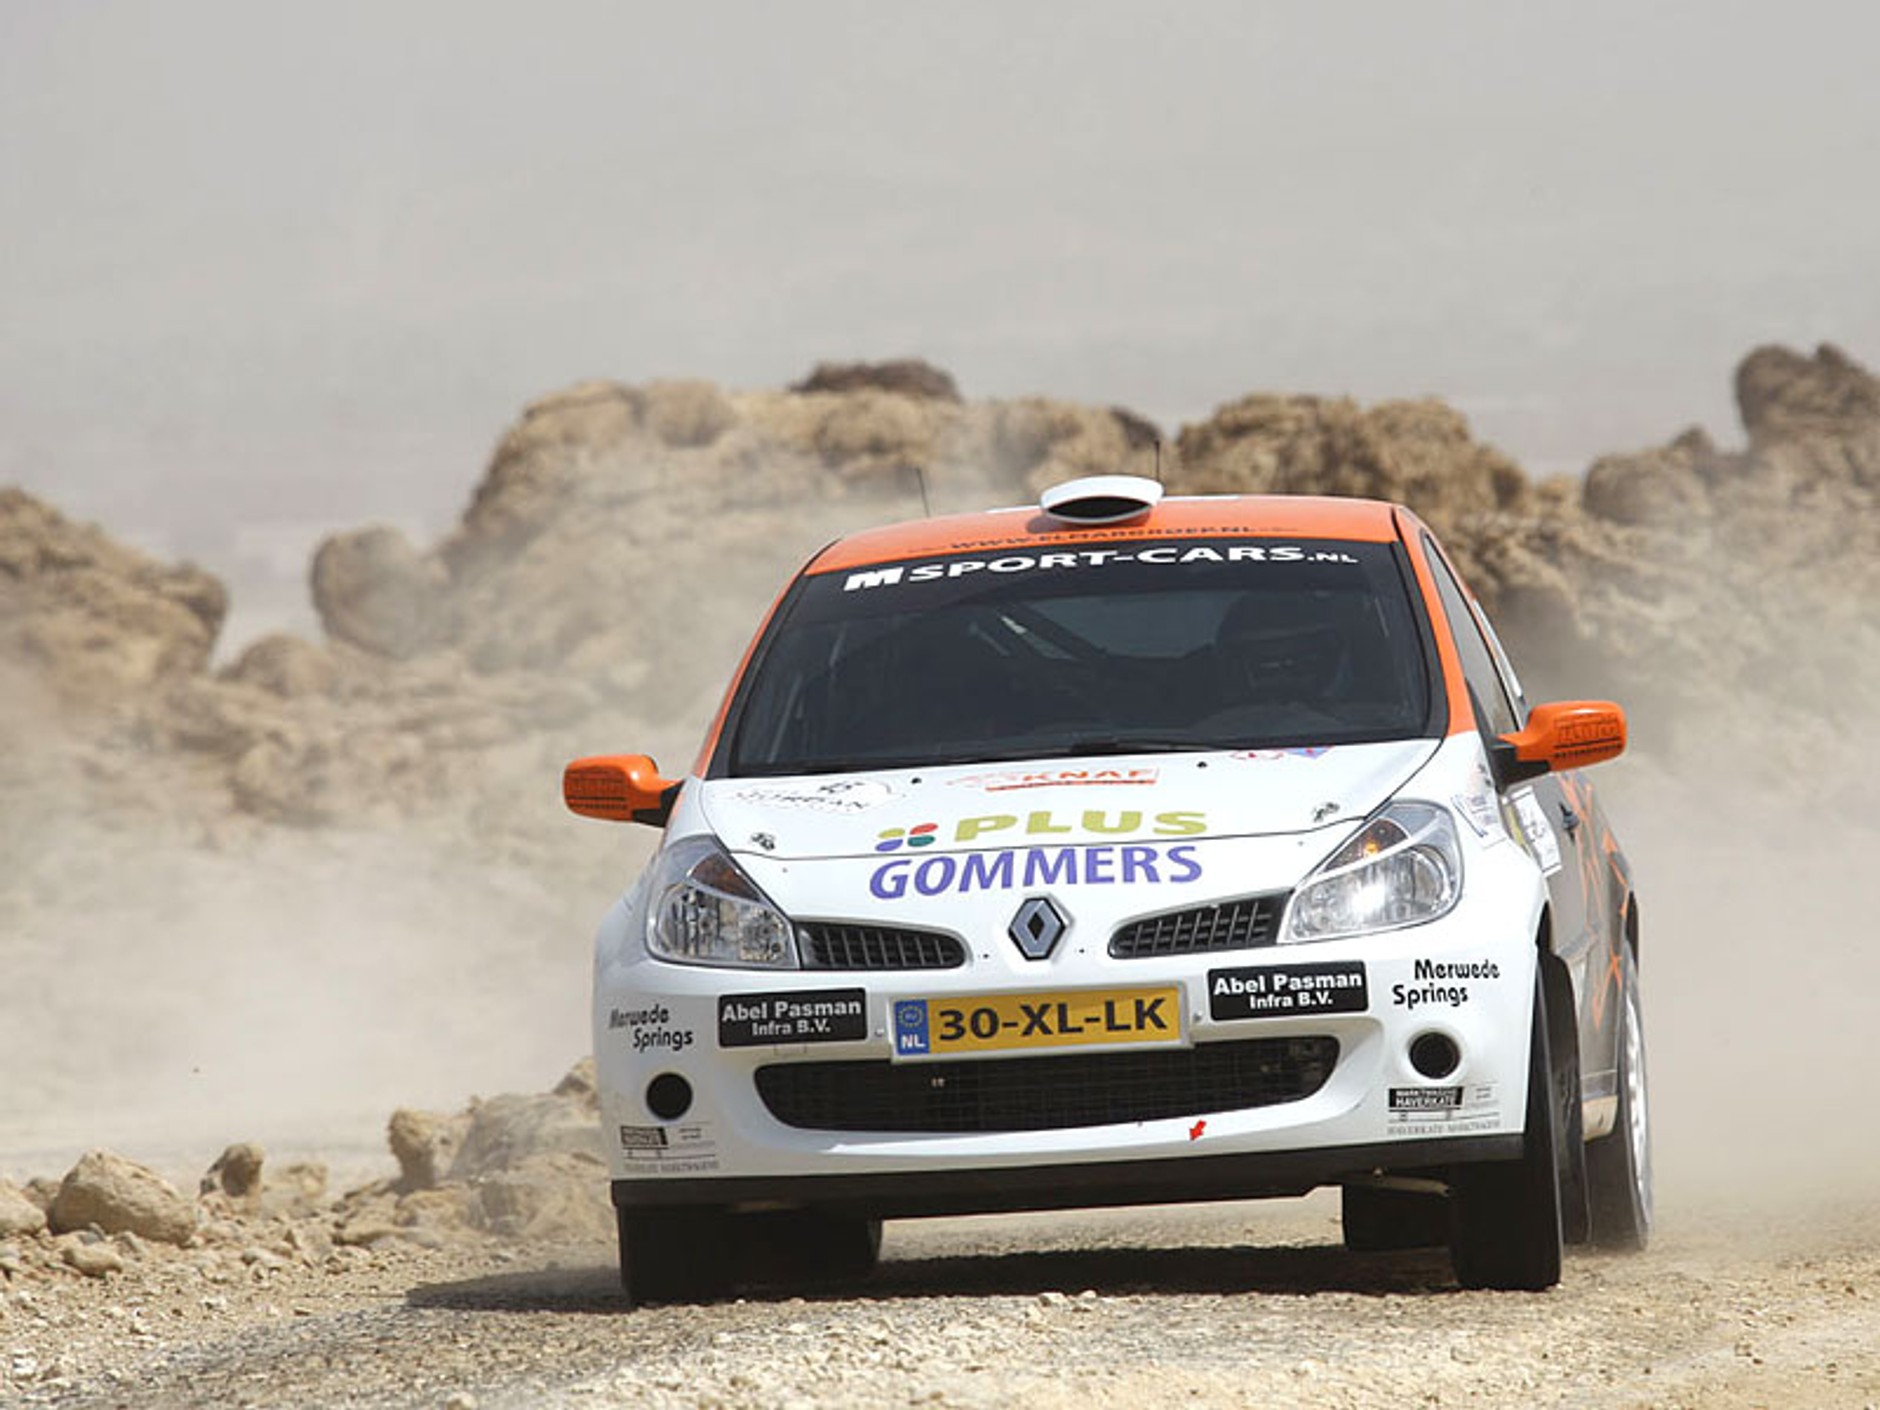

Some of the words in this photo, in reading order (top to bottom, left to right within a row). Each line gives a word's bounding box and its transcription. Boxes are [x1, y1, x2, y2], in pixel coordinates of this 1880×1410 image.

[954, 810, 1208, 842] PLUS
[869, 845, 1203, 900] GOMMERS
[1414, 959, 1501, 981] Merwede
[1213, 973, 1266, 997] Abel
[1273, 971, 1363, 991] Pasman
[1393, 983, 1469, 1008] Springs
[721, 998, 768, 1024] Abel
[774, 997, 862, 1020] Pasman
[1249, 993, 1294, 1011] Infra
[1298, 990, 1334, 1008] B.V.
[752, 1018, 793, 1037] Infra
[796, 1016, 831, 1036] B.V.
[938, 997, 1168, 1041] 30-XL-LK
[632, 1026, 694, 1053] Springs
[901, 1034, 926, 1048] NL
